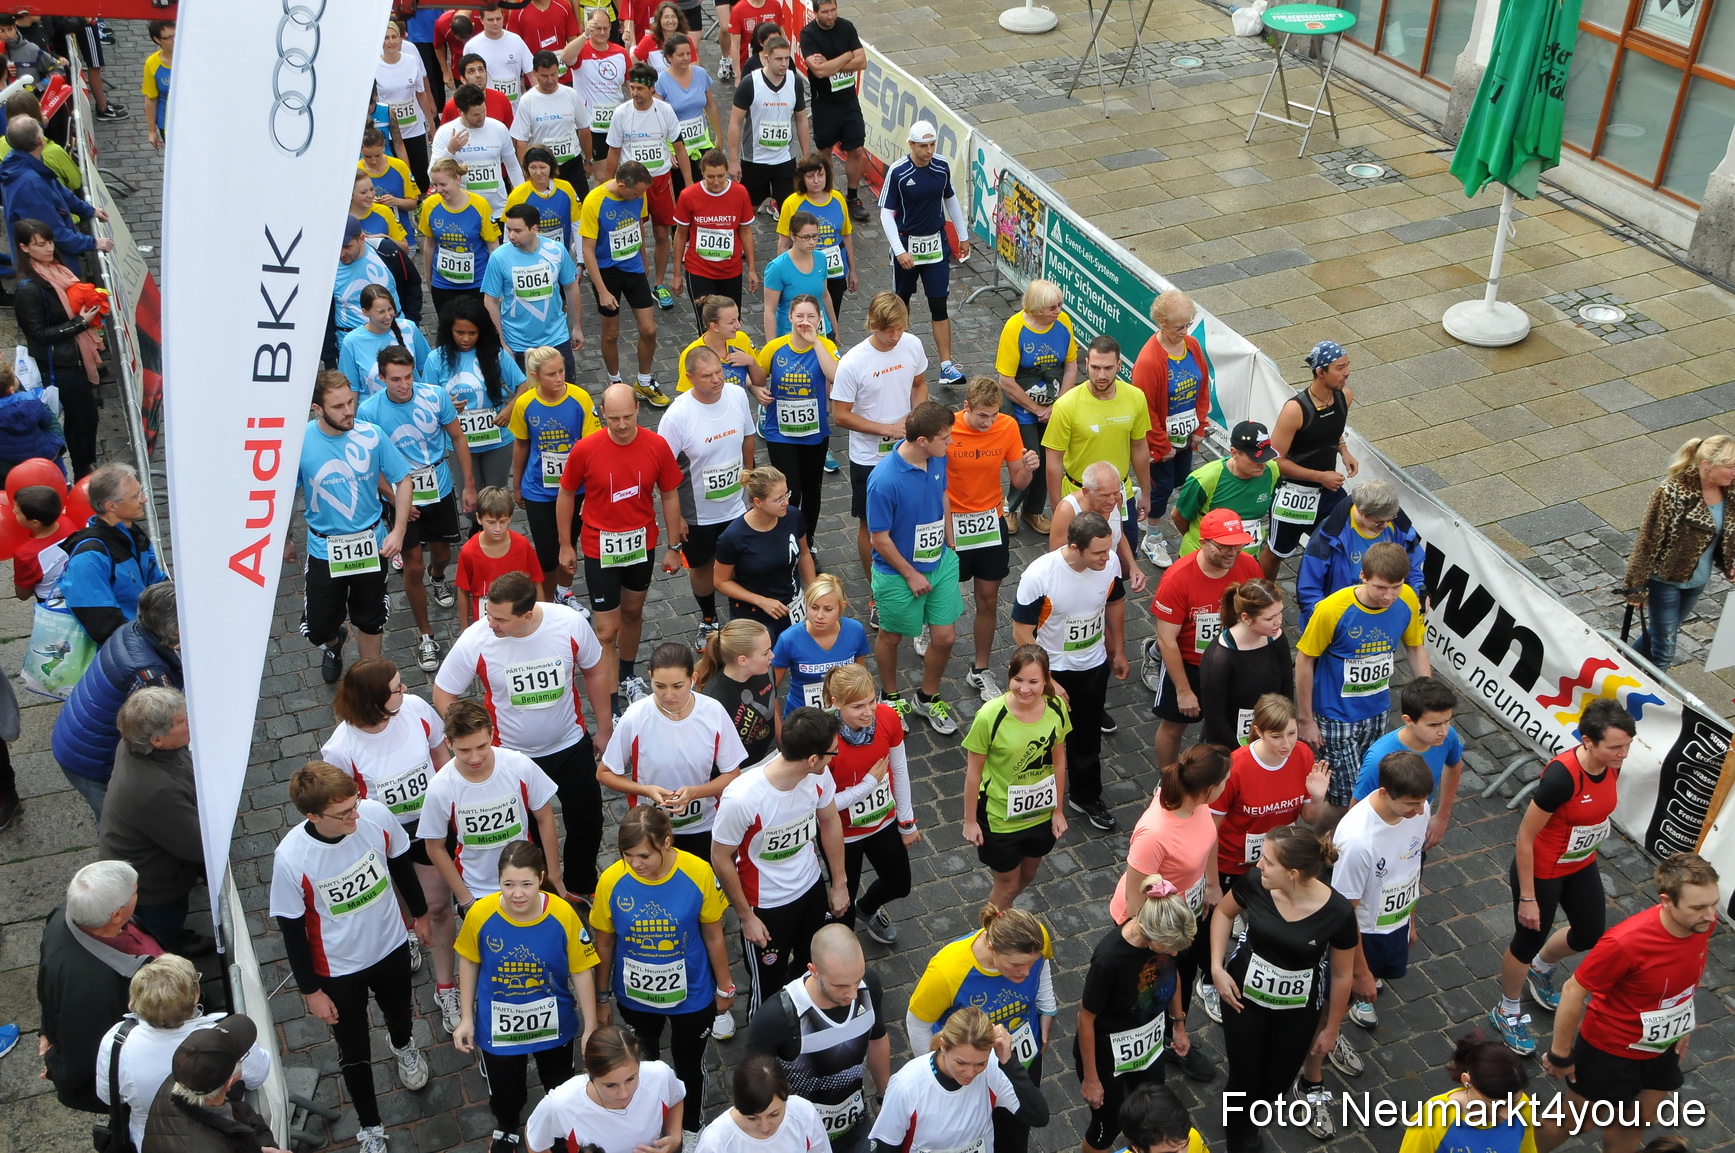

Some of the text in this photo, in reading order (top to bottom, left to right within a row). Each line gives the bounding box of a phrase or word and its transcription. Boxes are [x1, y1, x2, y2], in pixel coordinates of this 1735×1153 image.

[595, 110, 613, 121] 522
[681, 123, 703, 140] 5027
[762, 127, 788, 141] 5146
[634, 147, 663, 161] 5505
[468, 168, 495, 183] 5501
[694, 215, 732, 223] NEUMARKT
[613, 230, 641, 250] 5143
[700, 234, 731, 250] 5046
[911, 240, 939, 254] 5012
[440, 257, 471, 273] 5018
[826, 251, 840, 267] 73
[1064, 233, 1120, 284] Event-Leit-Systeme
[516, 271, 551, 289] 5064
[1048, 250, 1122, 323] Mehr Sicherheit
[1062, 281, 1076, 305] Ihr
[1077, 292, 1107, 334] Event!
[228, 223, 304, 588] Audi BKK
[781, 407, 816, 423] 5153
[461, 414, 495, 433] 5120
[1171, 423, 1198, 442] 5057
[953, 447, 1004, 459] EURO POLES
[547, 461, 563, 475] 51
[708, 467, 740, 490] 5527
[1281, 490, 1317, 510] 5002
[957, 515, 996, 535] 5522
[604, 534, 644, 555] 5119
[919, 528, 945, 548] 552
[332, 540, 375, 561] 5140
[611, 551, 637, 563] Michael
[343, 560, 367, 570] Ashley
[792, 603, 805, 623] 51
[1069, 616, 1102, 641] 5114
[1201, 623, 1220, 640] 55
[505, 661, 554, 675] PARTL Neumarkt
[1349, 662, 1391, 684] 5086
[512, 667, 560, 693] 5191
[520, 691, 558, 706] Benjamin
[1469, 666, 1566, 759] neumark
[740, 707, 755, 741] orld
[1013, 745, 1036, 772] GOSSEN
[376, 766, 422, 790] PARTL Neumarkt
[1692, 768, 1717, 786] Wasse
[384, 771, 429, 807] 5189
[1009, 783, 1051, 796] PARTL Neumarkt
[402, 800, 421, 813] Anja
[457, 801, 509, 816] PARTL Neumarkt
[1012, 788, 1054, 813] 5023
[1243, 798, 1300, 817] NEUMARKT
[465, 806, 516, 835] 5224
[765, 817, 809, 837] PARTL Neumarkt
[477, 831, 510, 845] Michael
[767, 822, 810, 852] 5211
[318, 860, 369, 890] PARTL Neumarkt
[327, 863, 380, 904] 5221
[347, 889, 378, 911] Markus
[1190, 887, 1204, 911] 51
[1381, 887, 1401, 896] PARTL
[1383, 879, 1418, 914] 5021
[624, 960, 676, 976] PARTL Neumarkt
[1251, 957, 1303, 981] PARTL Neumarkt
[629, 970, 682, 992] 5222
[1251, 968, 1305, 996] 5108
[645, 992, 666, 1004] Julia
[1259, 993, 1290, 1006] Andrea
[493, 1003, 546, 1014] PARTL Neumarkt
[498, 1011, 553, 1034] 5207
[1643, 1017, 1666, 1025] PARTL
[1646, 1012, 1692, 1043] 5172
[507, 1030, 544, 1042] Jennifer
[1112, 1020, 1160, 1044] PARTL Neumarkt
[1118, 1023, 1163, 1063] 5076
[825, 1099, 854, 1116] Neumarkt
[823, 1105, 859, 1133] 066
